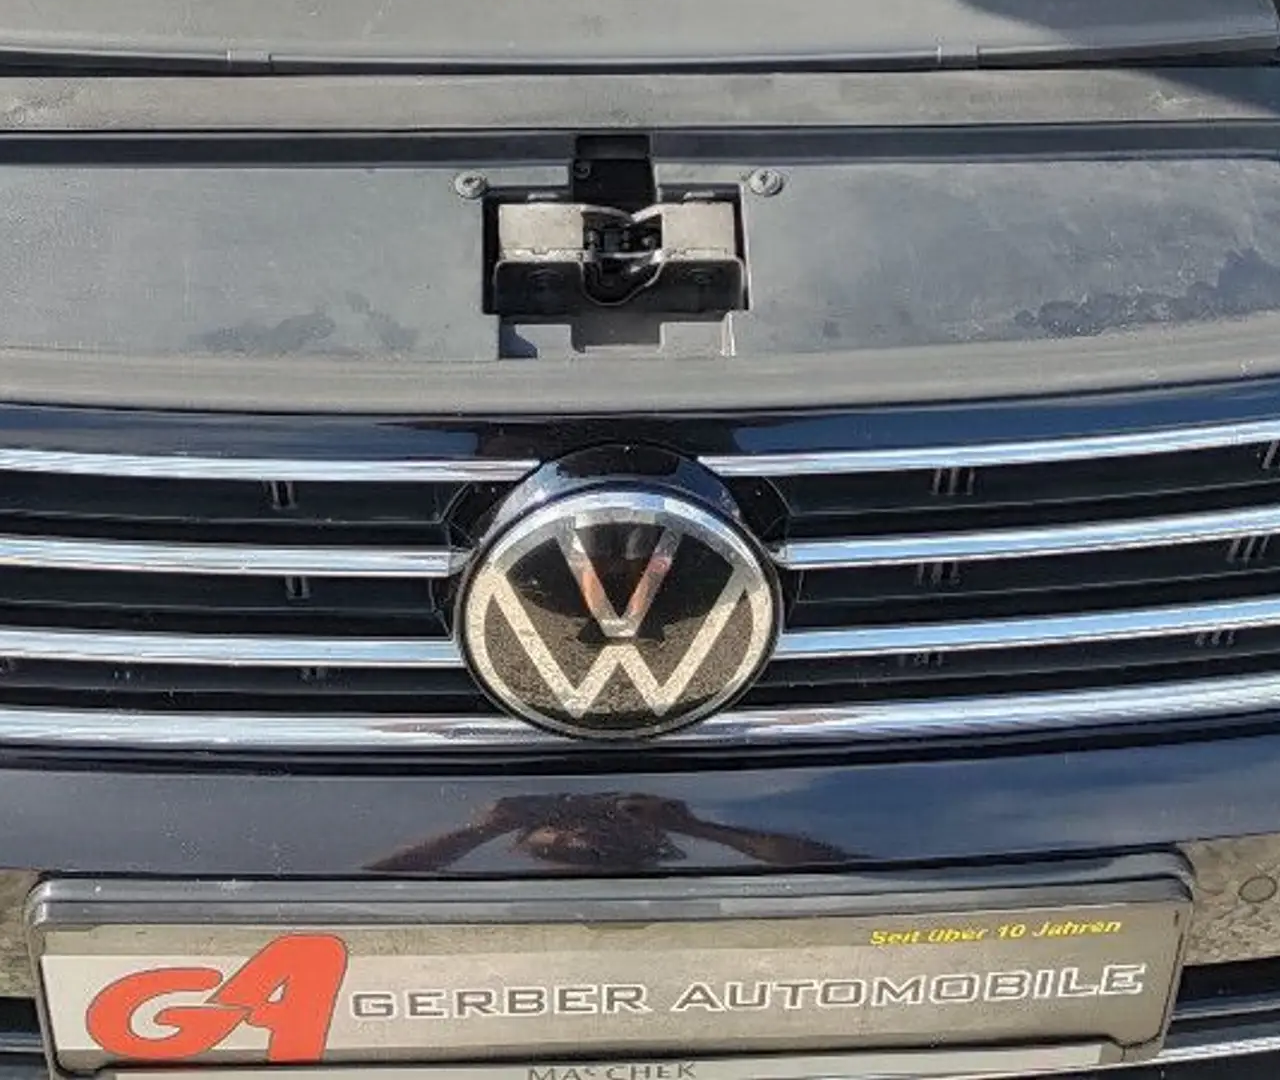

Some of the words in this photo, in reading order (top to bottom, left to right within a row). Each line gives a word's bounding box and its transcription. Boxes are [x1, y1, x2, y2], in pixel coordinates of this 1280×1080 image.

[486, 517, 748, 719] VW
[869, 929, 920, 946] Seit
[997, 923, 1026, 939] 10
[1032, 920, 1122, 938] Jahren
[85, 933, 348, 1062] GA
[351, 984, 652, 1019] GERBER
[670, 963, 1147, 1012] AUTOMOBILE
